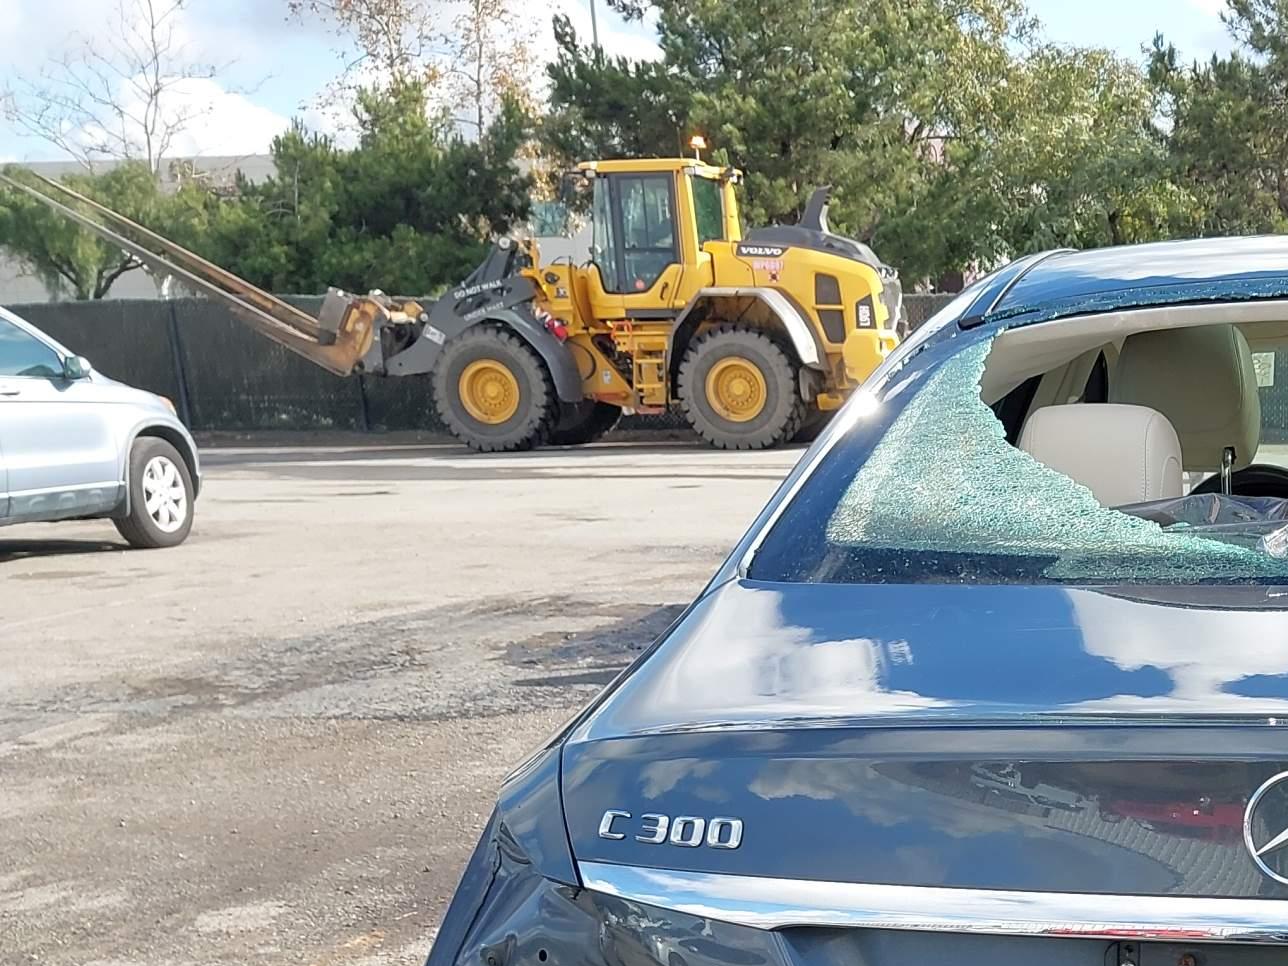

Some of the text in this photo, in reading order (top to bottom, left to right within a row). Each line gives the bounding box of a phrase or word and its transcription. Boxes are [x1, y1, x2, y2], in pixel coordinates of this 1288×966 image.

[740, 246, 782, 256] VOLVO
[598, 809, 744, 850] C 300
